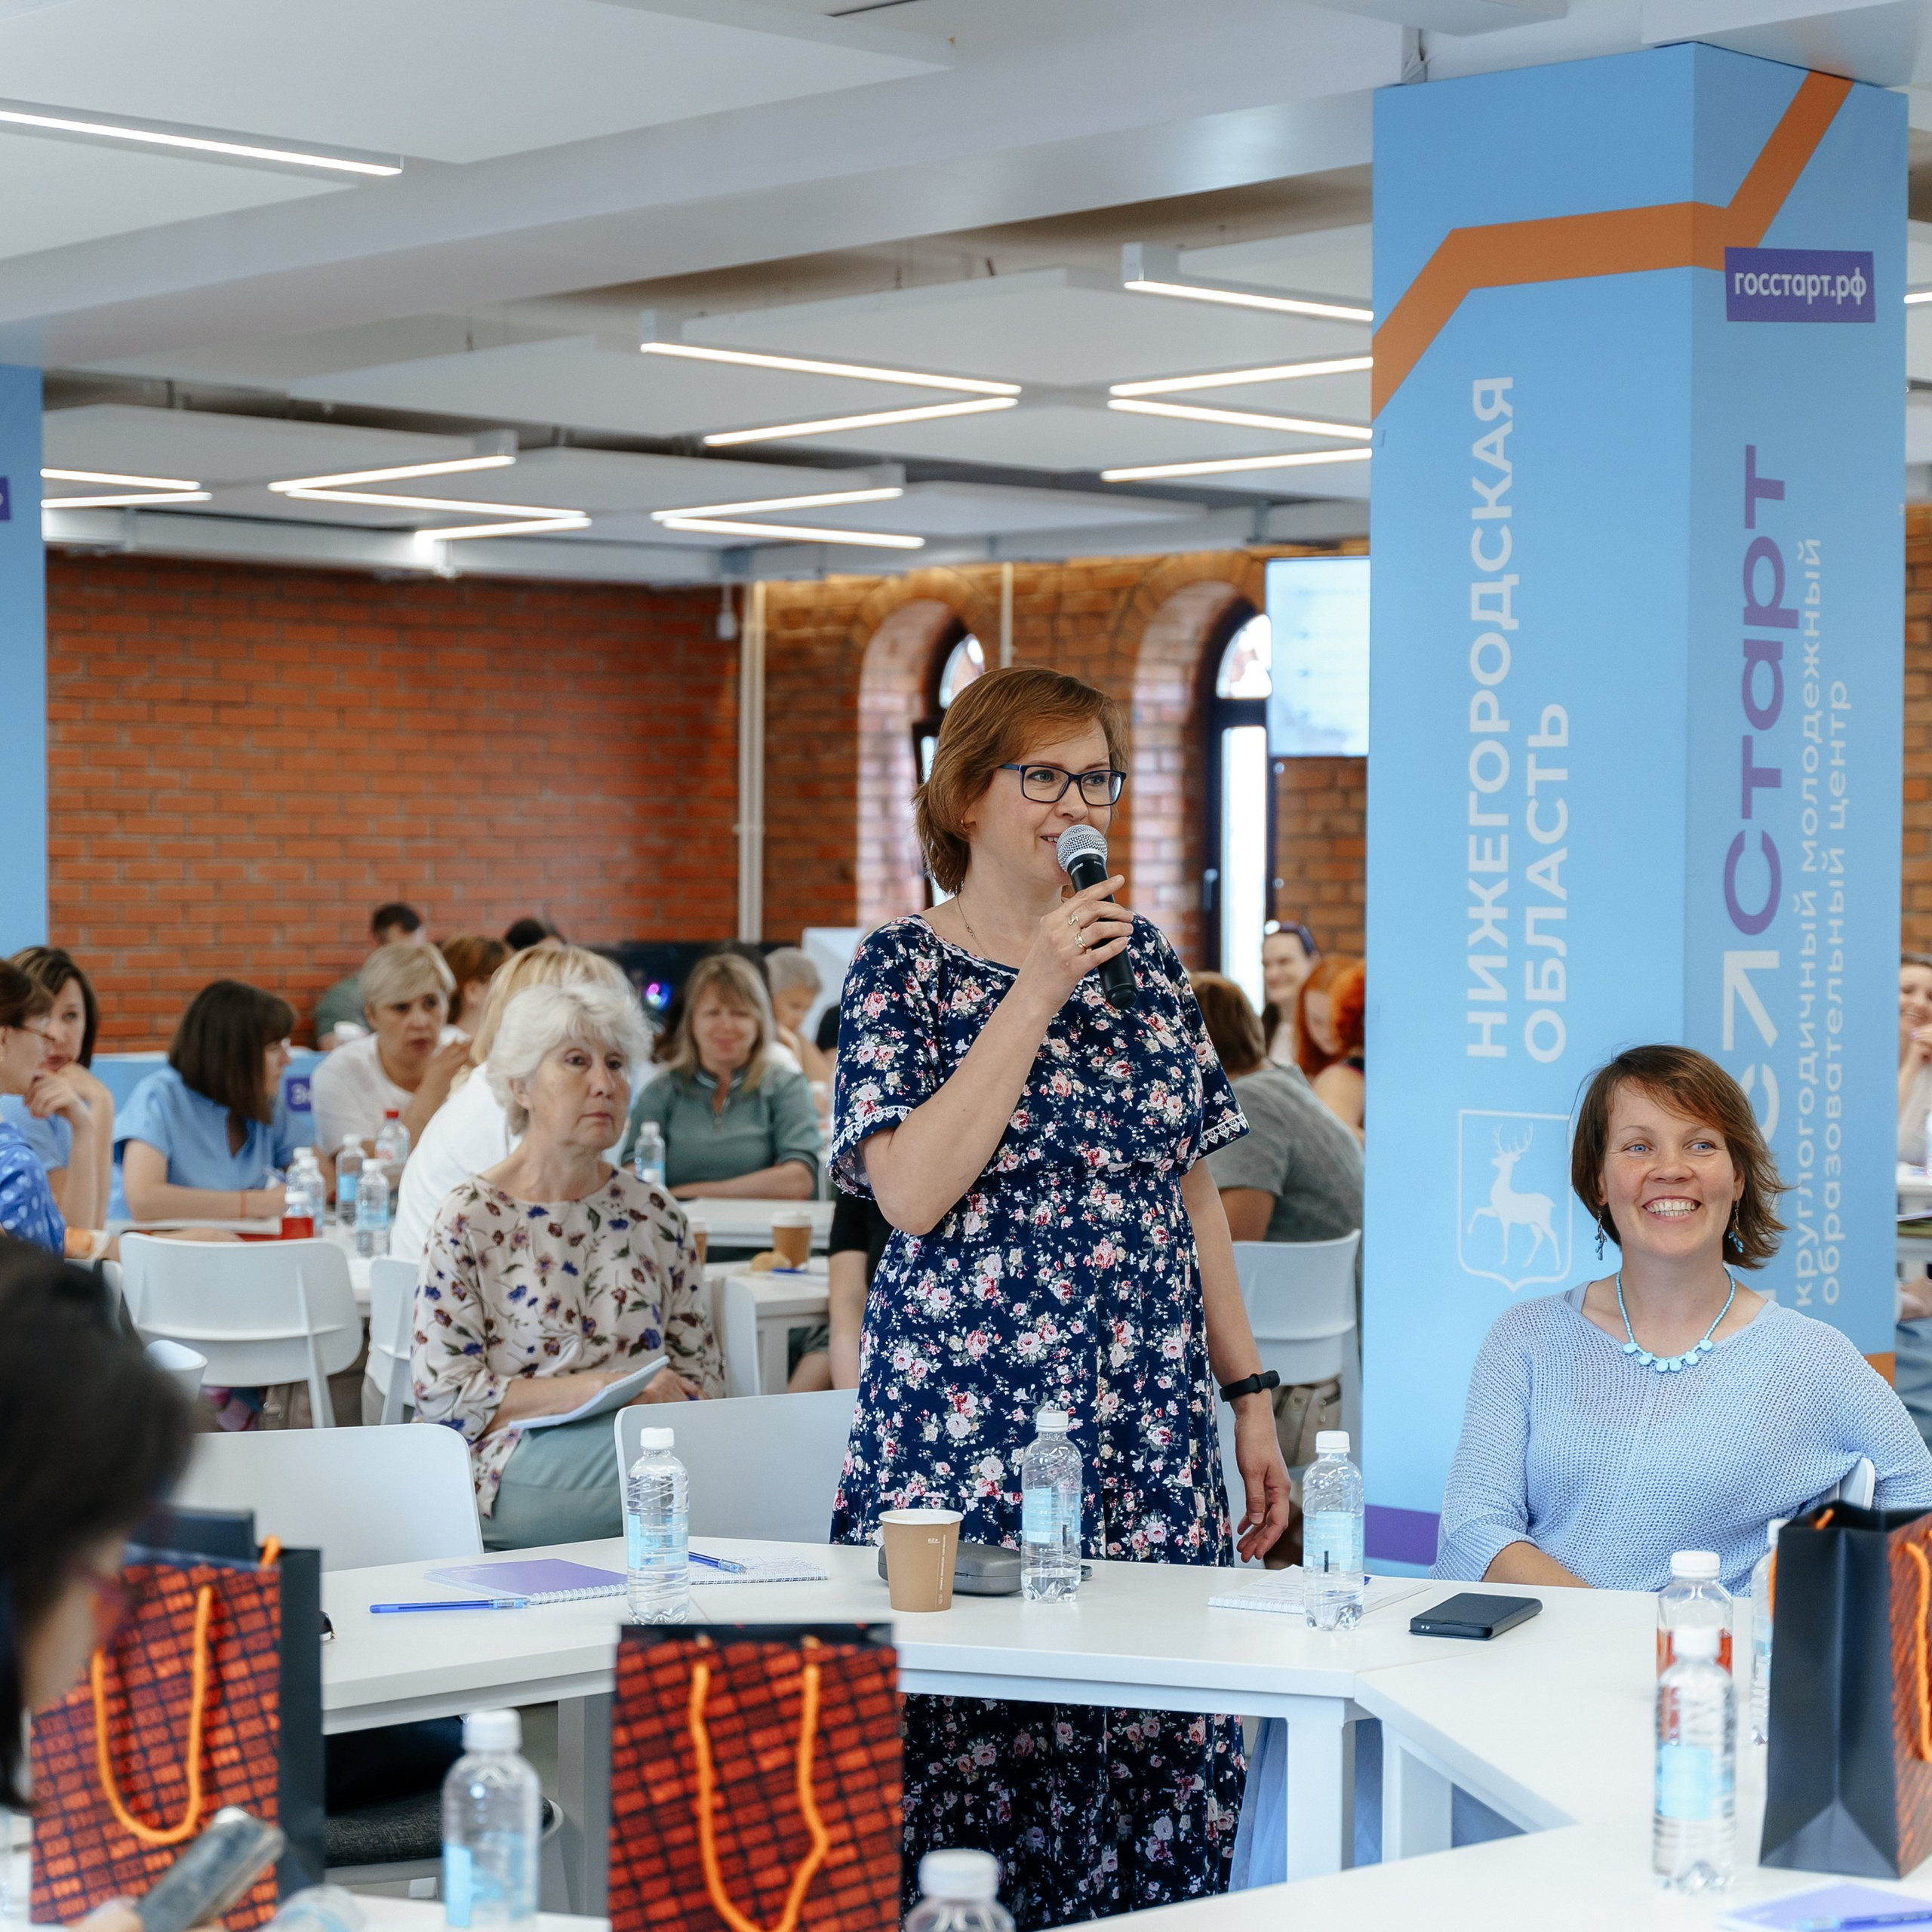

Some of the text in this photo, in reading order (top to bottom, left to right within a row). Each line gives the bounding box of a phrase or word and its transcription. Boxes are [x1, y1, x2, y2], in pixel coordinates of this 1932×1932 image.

[1734, 267, 1867, 305] госстарт.рф
[1467, 377, 1519, 1058] НИЖЕГОРОДСКАЯ
[1524, 703, 1569, 1063] ОБЛАСТЬ
[1793, 538, 1823, 1306] круглогодичный молодежный
[1817, 680, 1852, 1305] образовательный центр
